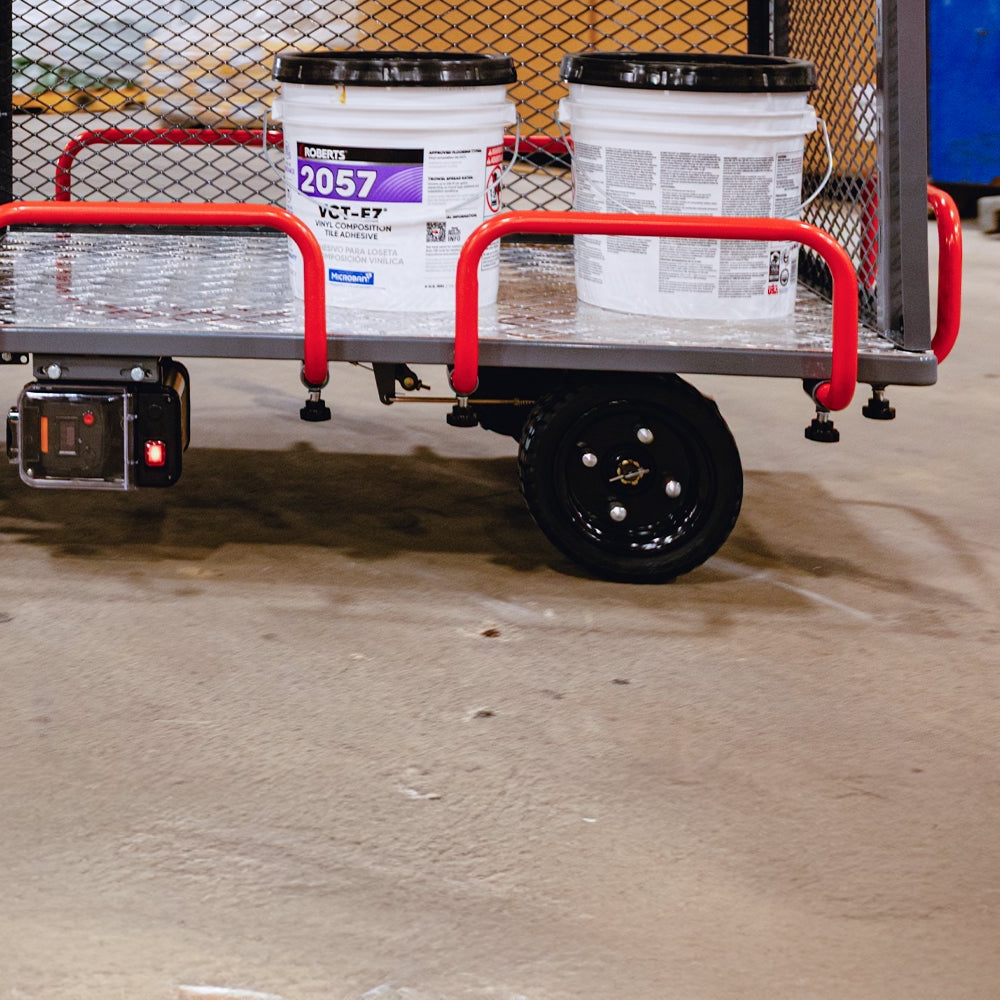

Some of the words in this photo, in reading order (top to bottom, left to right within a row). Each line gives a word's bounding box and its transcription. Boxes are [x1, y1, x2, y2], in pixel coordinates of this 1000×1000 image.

[304, 146, 346, 160] ROBERTS
[300, 164, 377, 199] 2057
[315, 220, 333, 229] VINYL
[335, 221, 392, 232] COMPOSITION
[325, 229, 338, 237] TILE
[340, 230, 378, 240] ADHESIVE
[345, 246, 366, 255] PARA
[368, 248, 398, 257] LOSETA
